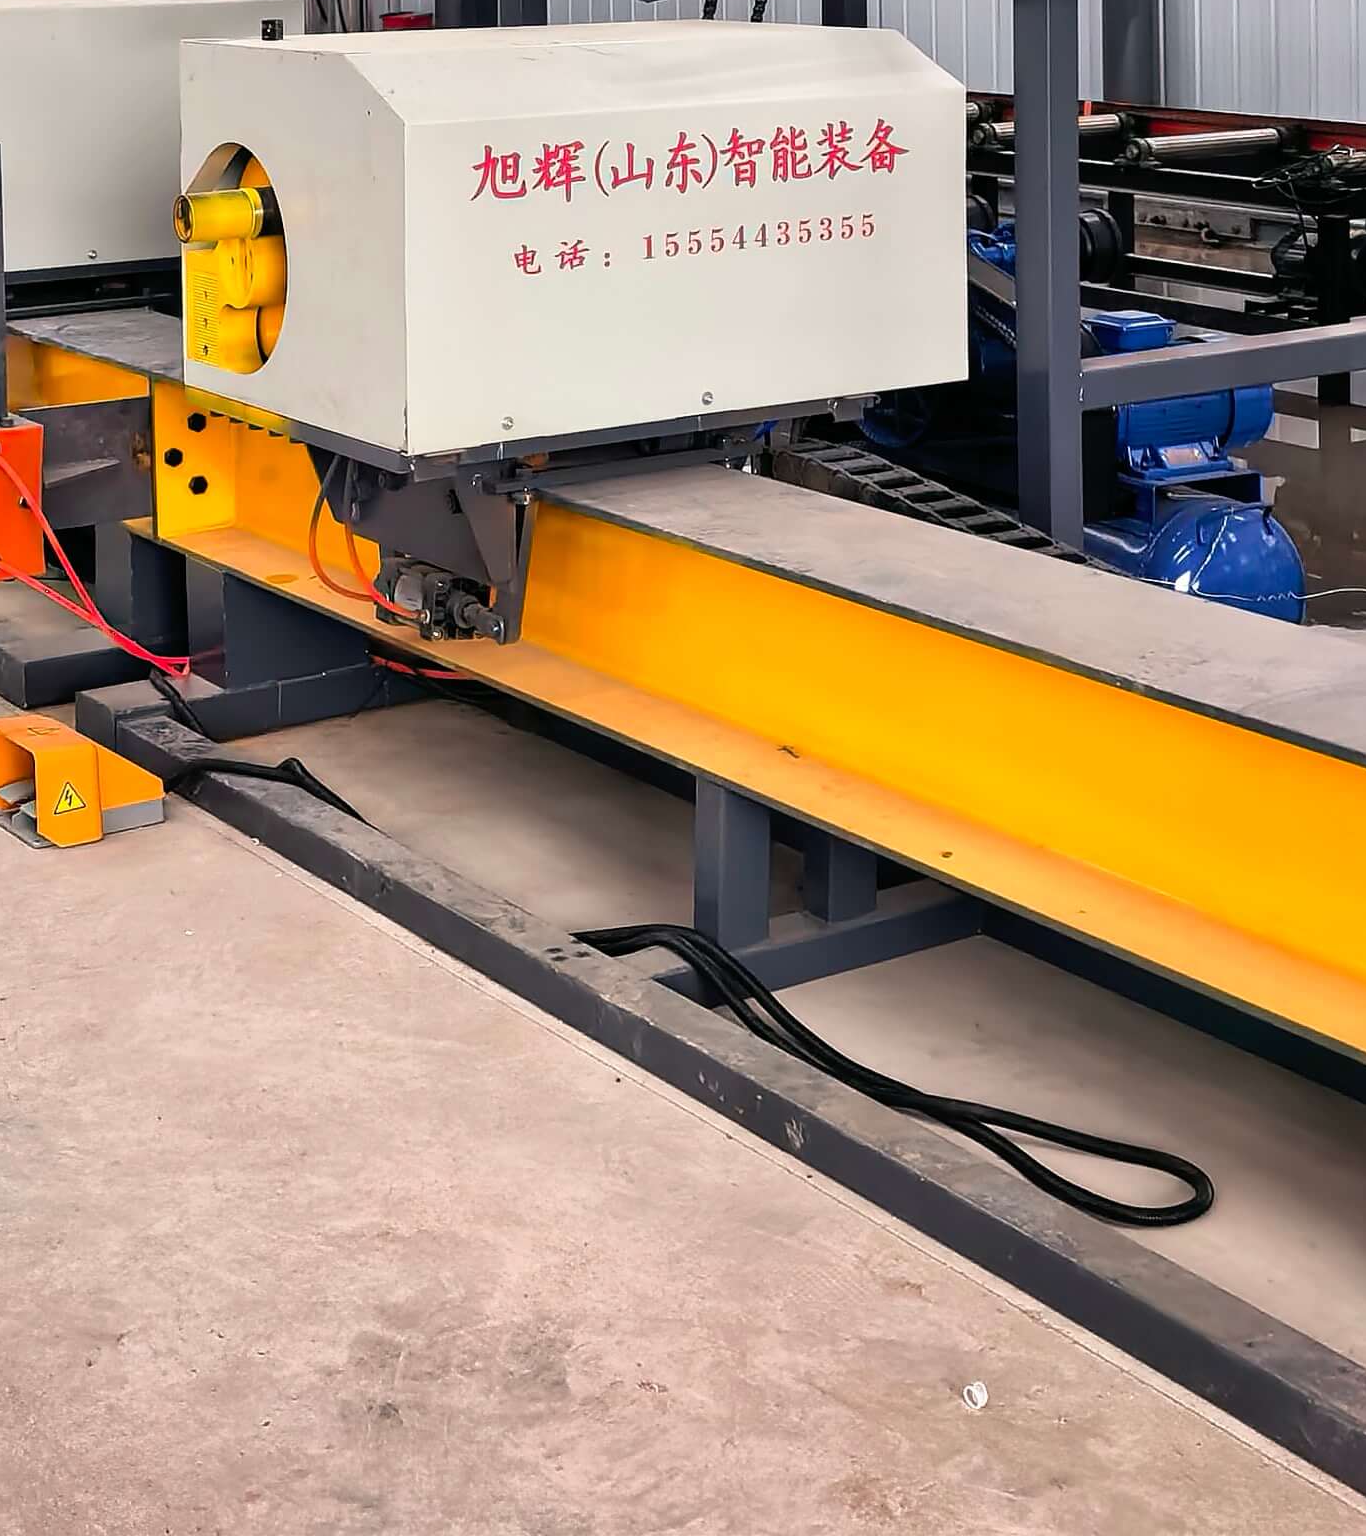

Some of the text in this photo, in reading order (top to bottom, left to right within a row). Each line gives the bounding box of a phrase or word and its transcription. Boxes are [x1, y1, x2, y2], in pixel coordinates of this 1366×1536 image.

[470, 117, 910, 203] 旭辉(山东)智能装备
[643, 212, 876, 262] 15554435355
